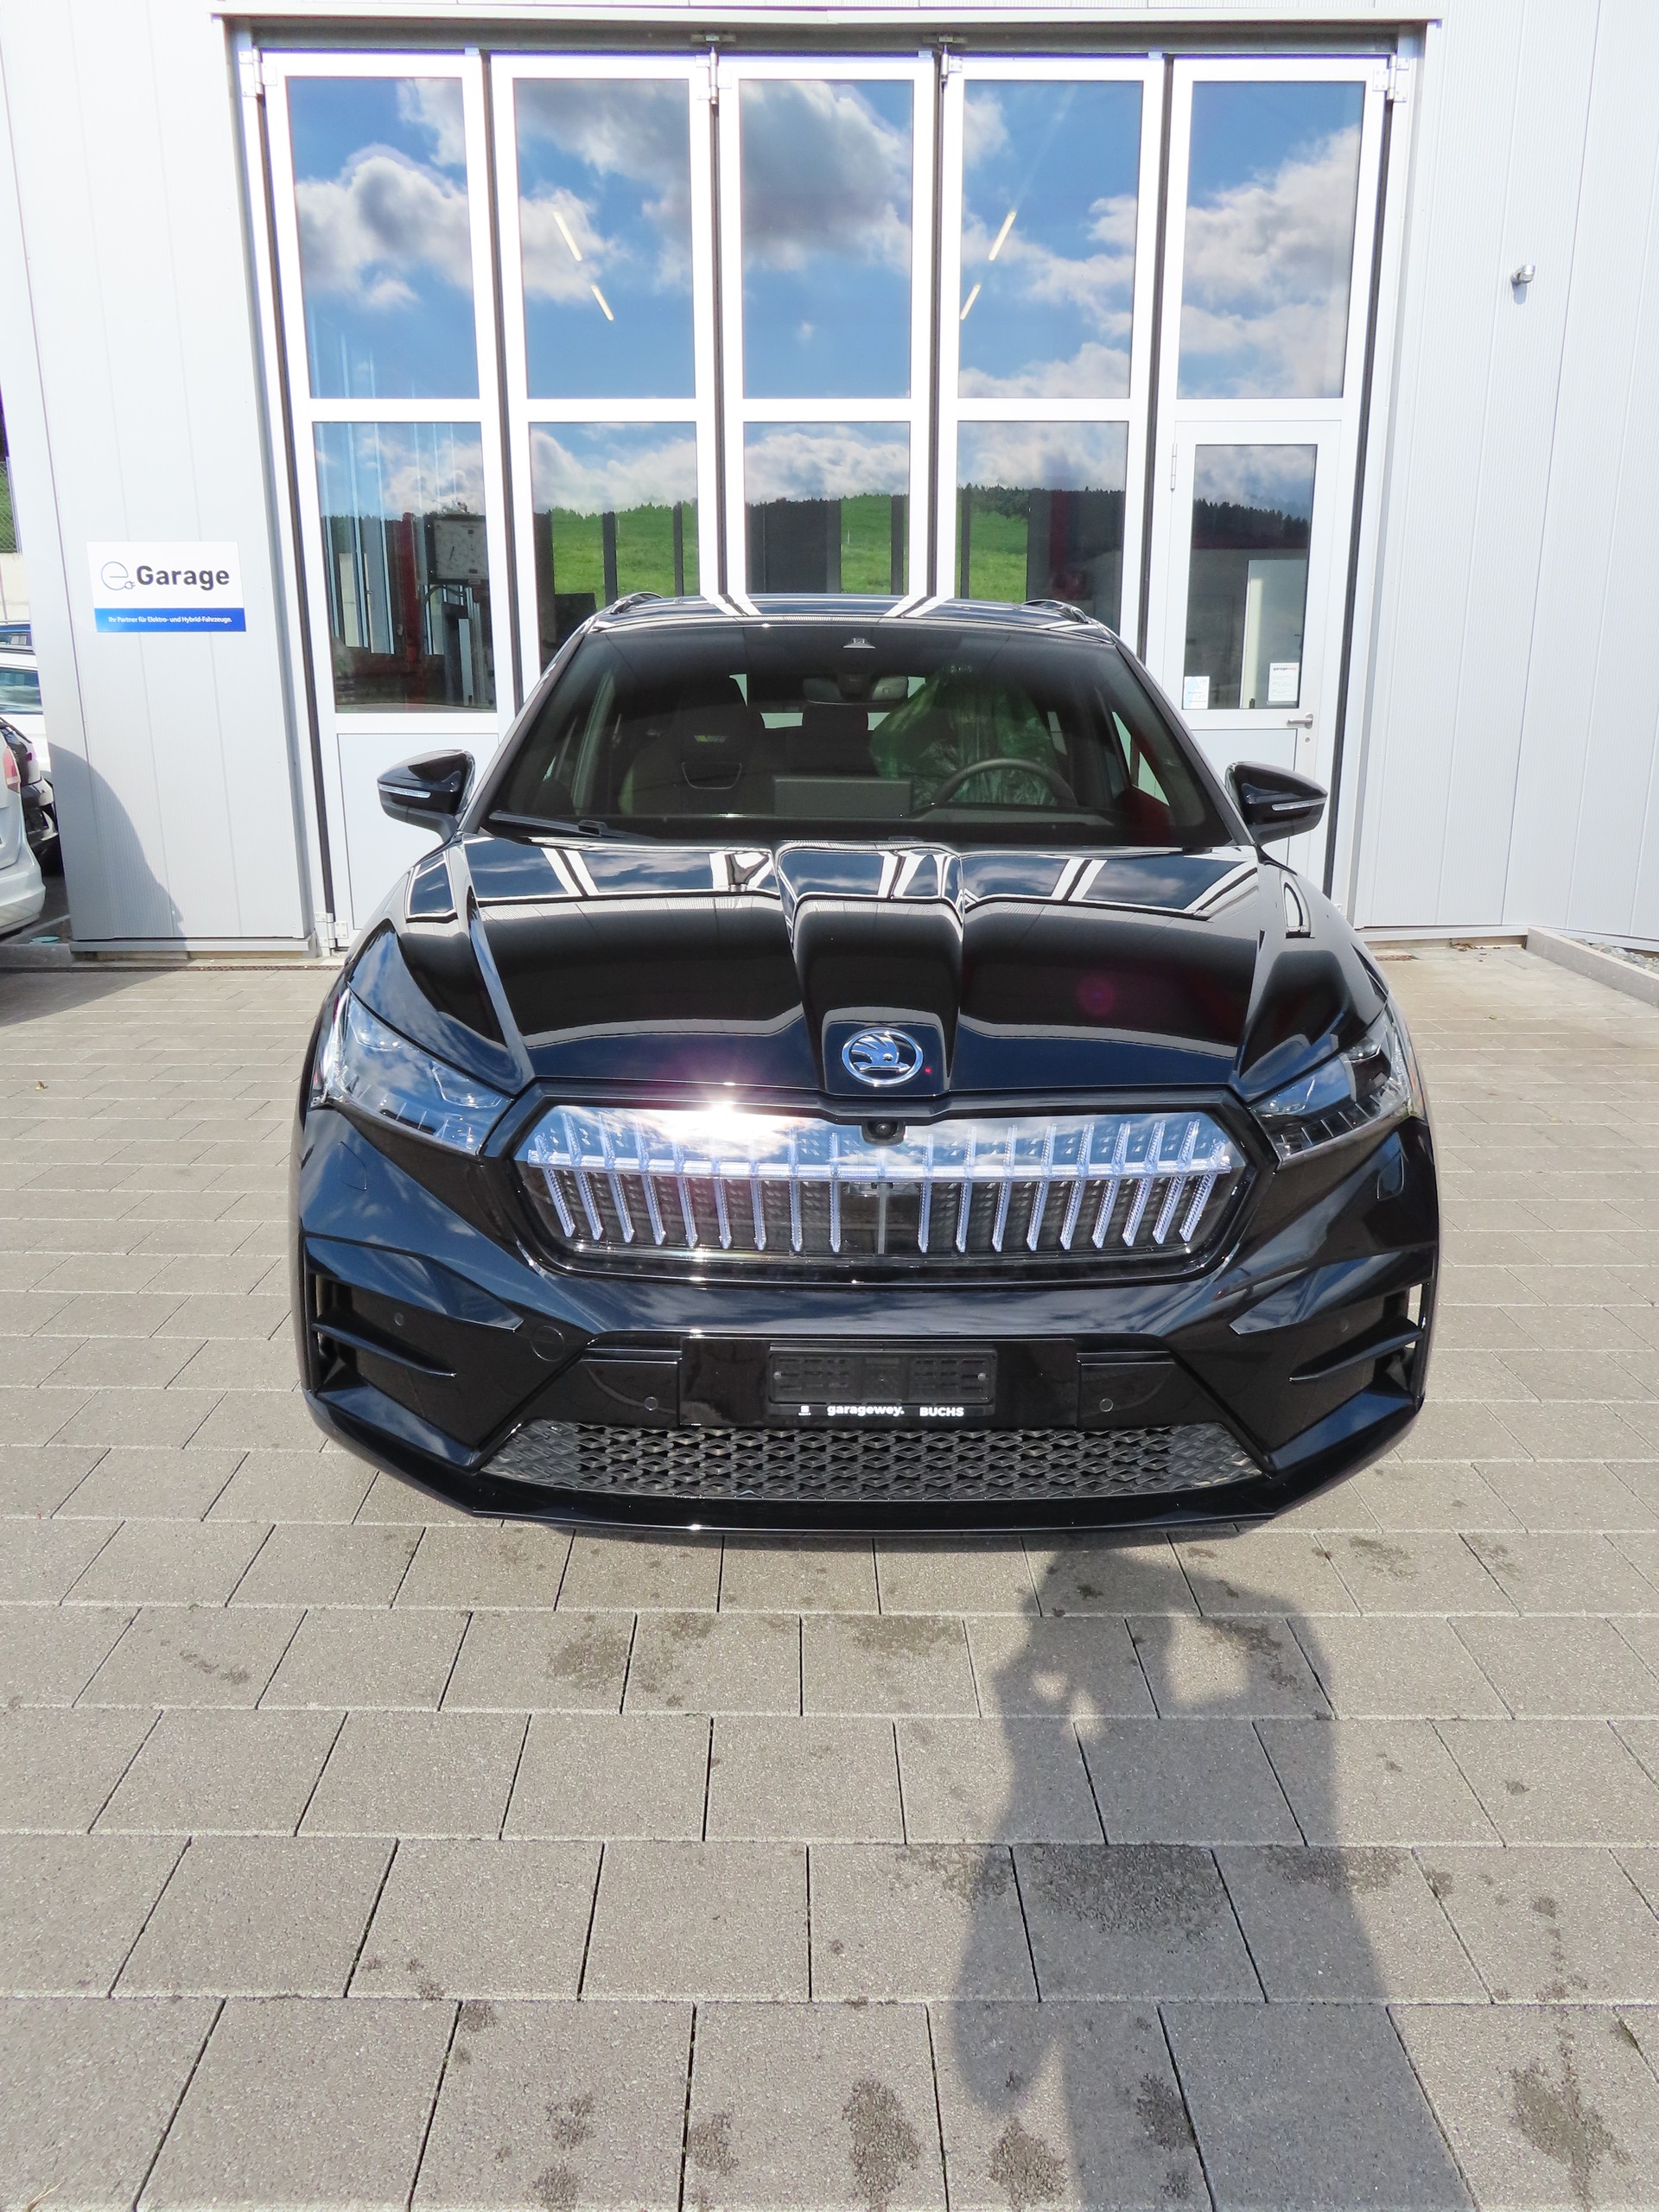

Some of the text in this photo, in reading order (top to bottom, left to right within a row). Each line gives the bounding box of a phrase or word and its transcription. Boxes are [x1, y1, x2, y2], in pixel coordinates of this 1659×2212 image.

[137, 565, 230, 591] Garage
[827, 1405, 965, 1417] garagewey. BUCHS
